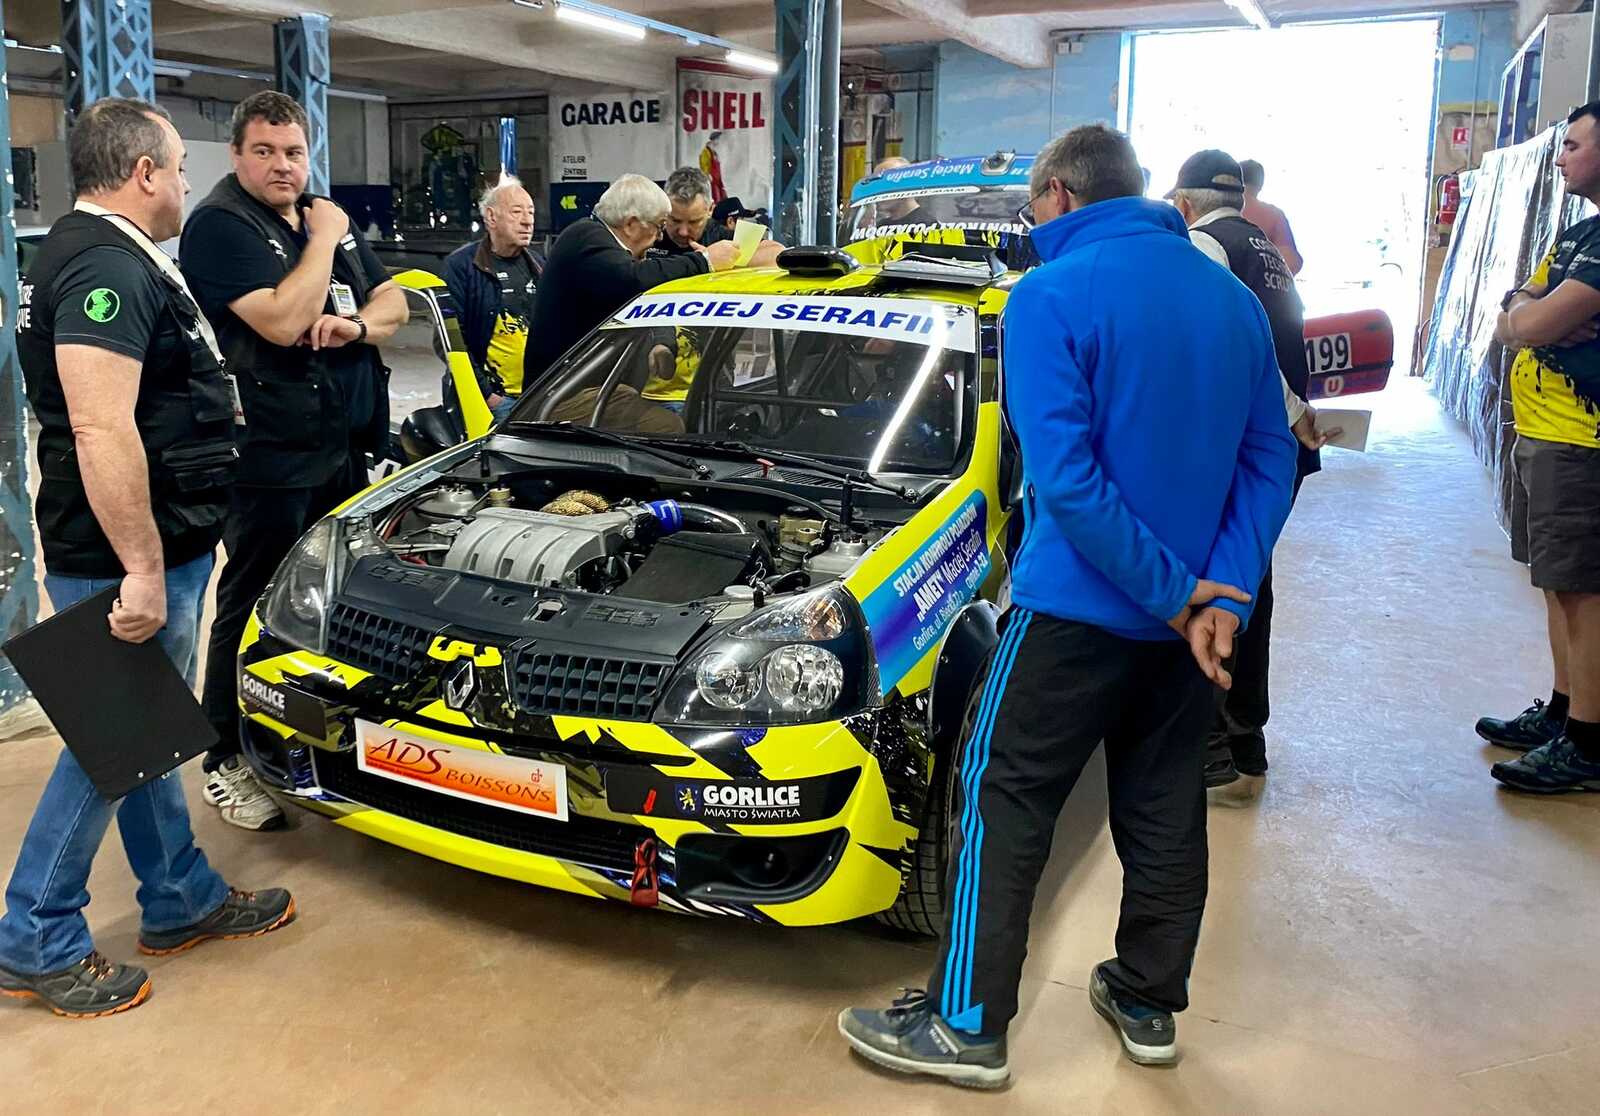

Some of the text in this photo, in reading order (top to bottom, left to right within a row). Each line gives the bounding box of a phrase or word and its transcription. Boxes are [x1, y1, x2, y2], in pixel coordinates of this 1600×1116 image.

[561, 99, 660, 127] GARAGE
[682, 88, 766, 133] SHELL
[625, 301, 763, 320] MACIEJ
[1305, 335, 1350, 373] 199
[893, 561, 925, 597] STACJA
[940, 547, 970, 584] Maciej
[242, 674, 286, 710] GORLICE
[369, 738, 451, 774] ADS
[446, 767, 553, 801] BOISSONS
[703, 785, 800, 806] GORLICE
[703, 807, 801, 819] MIASTO ŚWIATŁA
